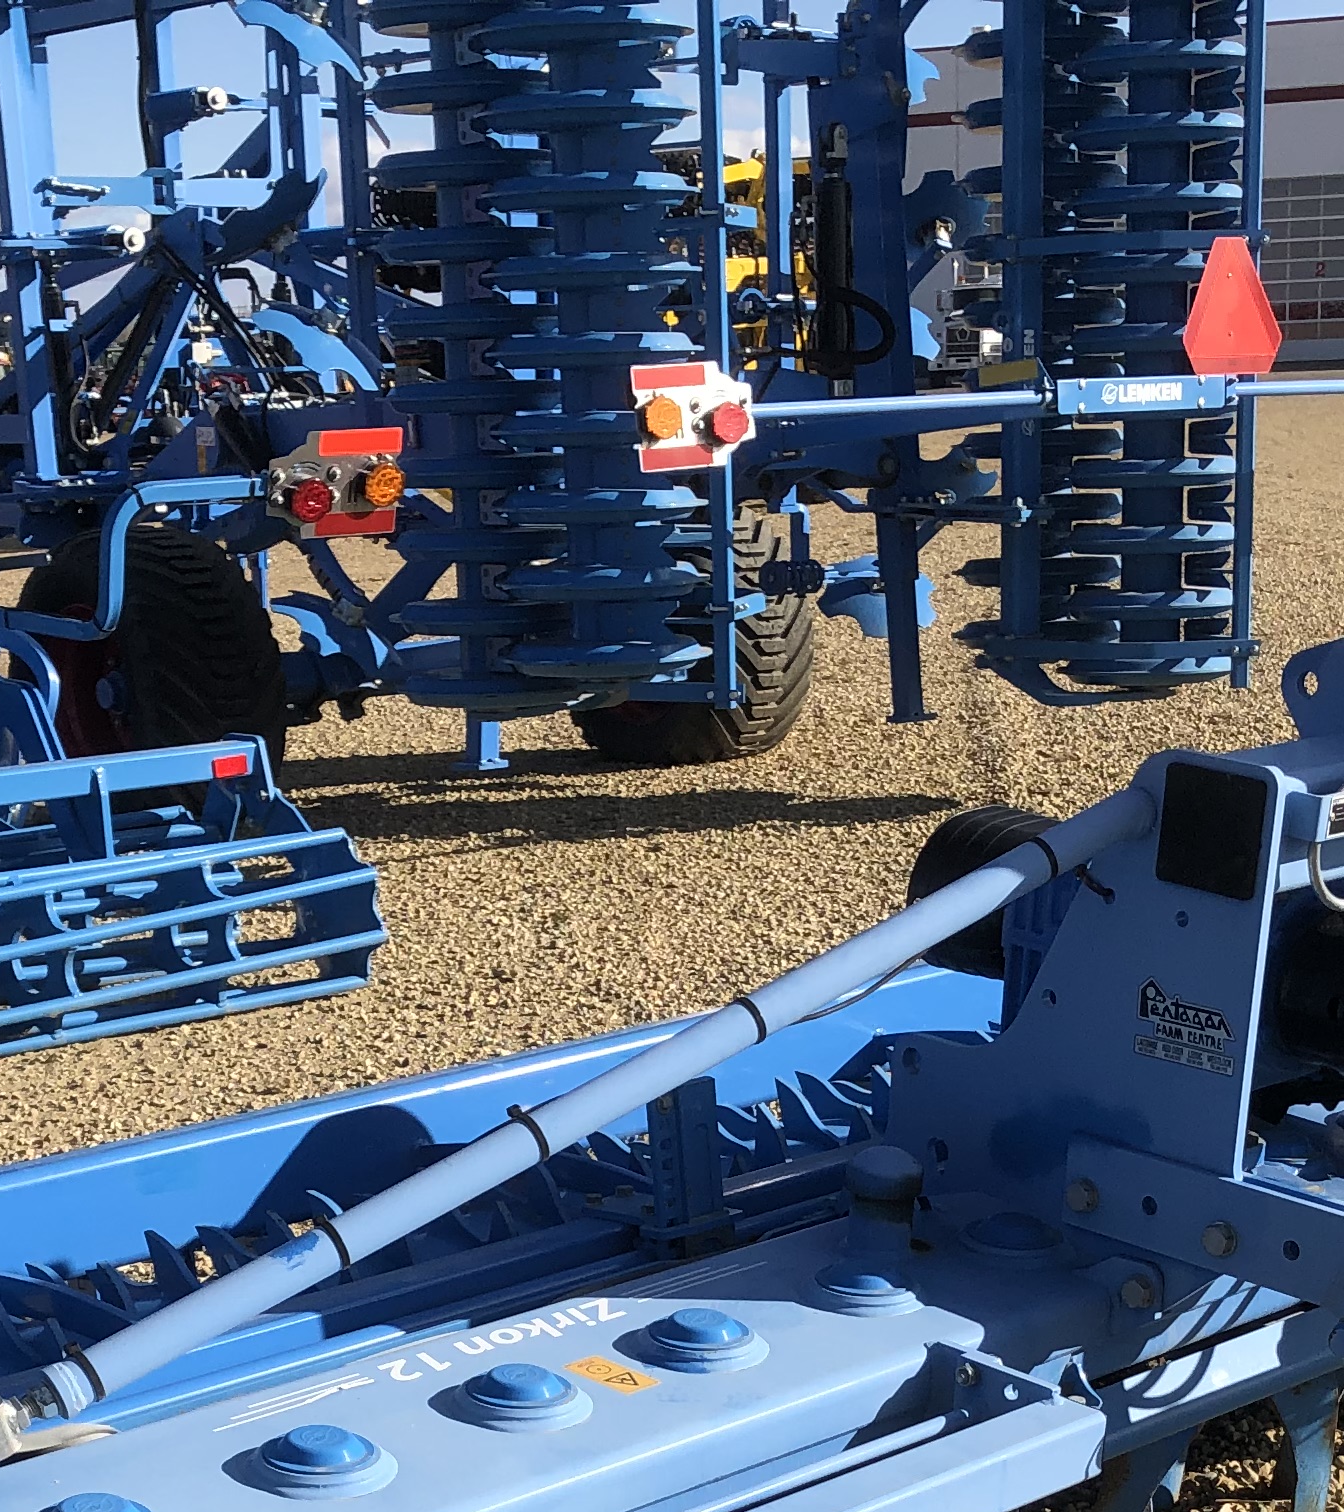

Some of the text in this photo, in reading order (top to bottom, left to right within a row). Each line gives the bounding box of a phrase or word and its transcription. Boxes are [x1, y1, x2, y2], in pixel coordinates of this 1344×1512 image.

[1315, 262, 1325, 277] 2
[1119, 382, 1183, 405] LEMKEN
[1156, 1023, 1223, 1051] FARM CENTRE
[377, 1298, 628, 1381] Zirkon 12
